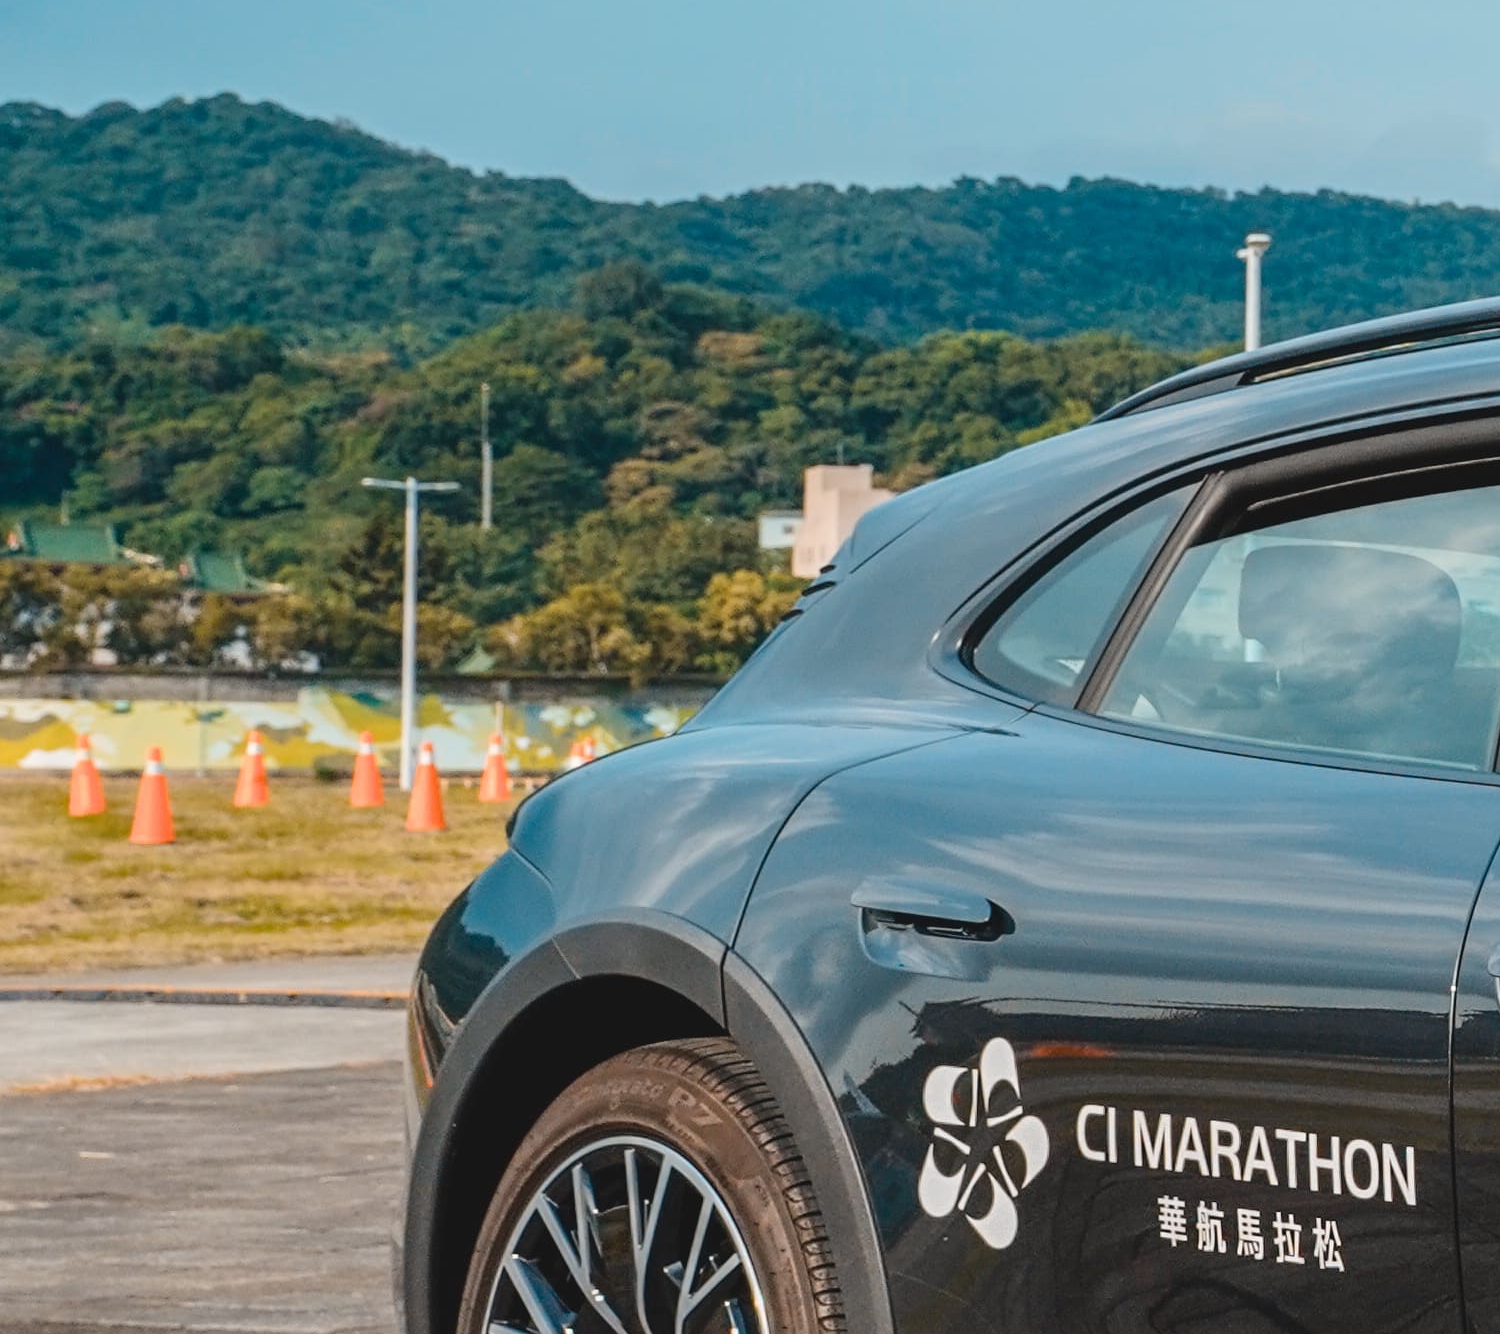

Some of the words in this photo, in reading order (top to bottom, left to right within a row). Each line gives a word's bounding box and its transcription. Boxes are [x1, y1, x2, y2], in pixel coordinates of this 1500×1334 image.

[1076, 1102, 1119, 1164] CI
[1132, 1107, 1418, 1207] MARATHON
[1157, 1194, 1347, 1272] 華航馬拉松
